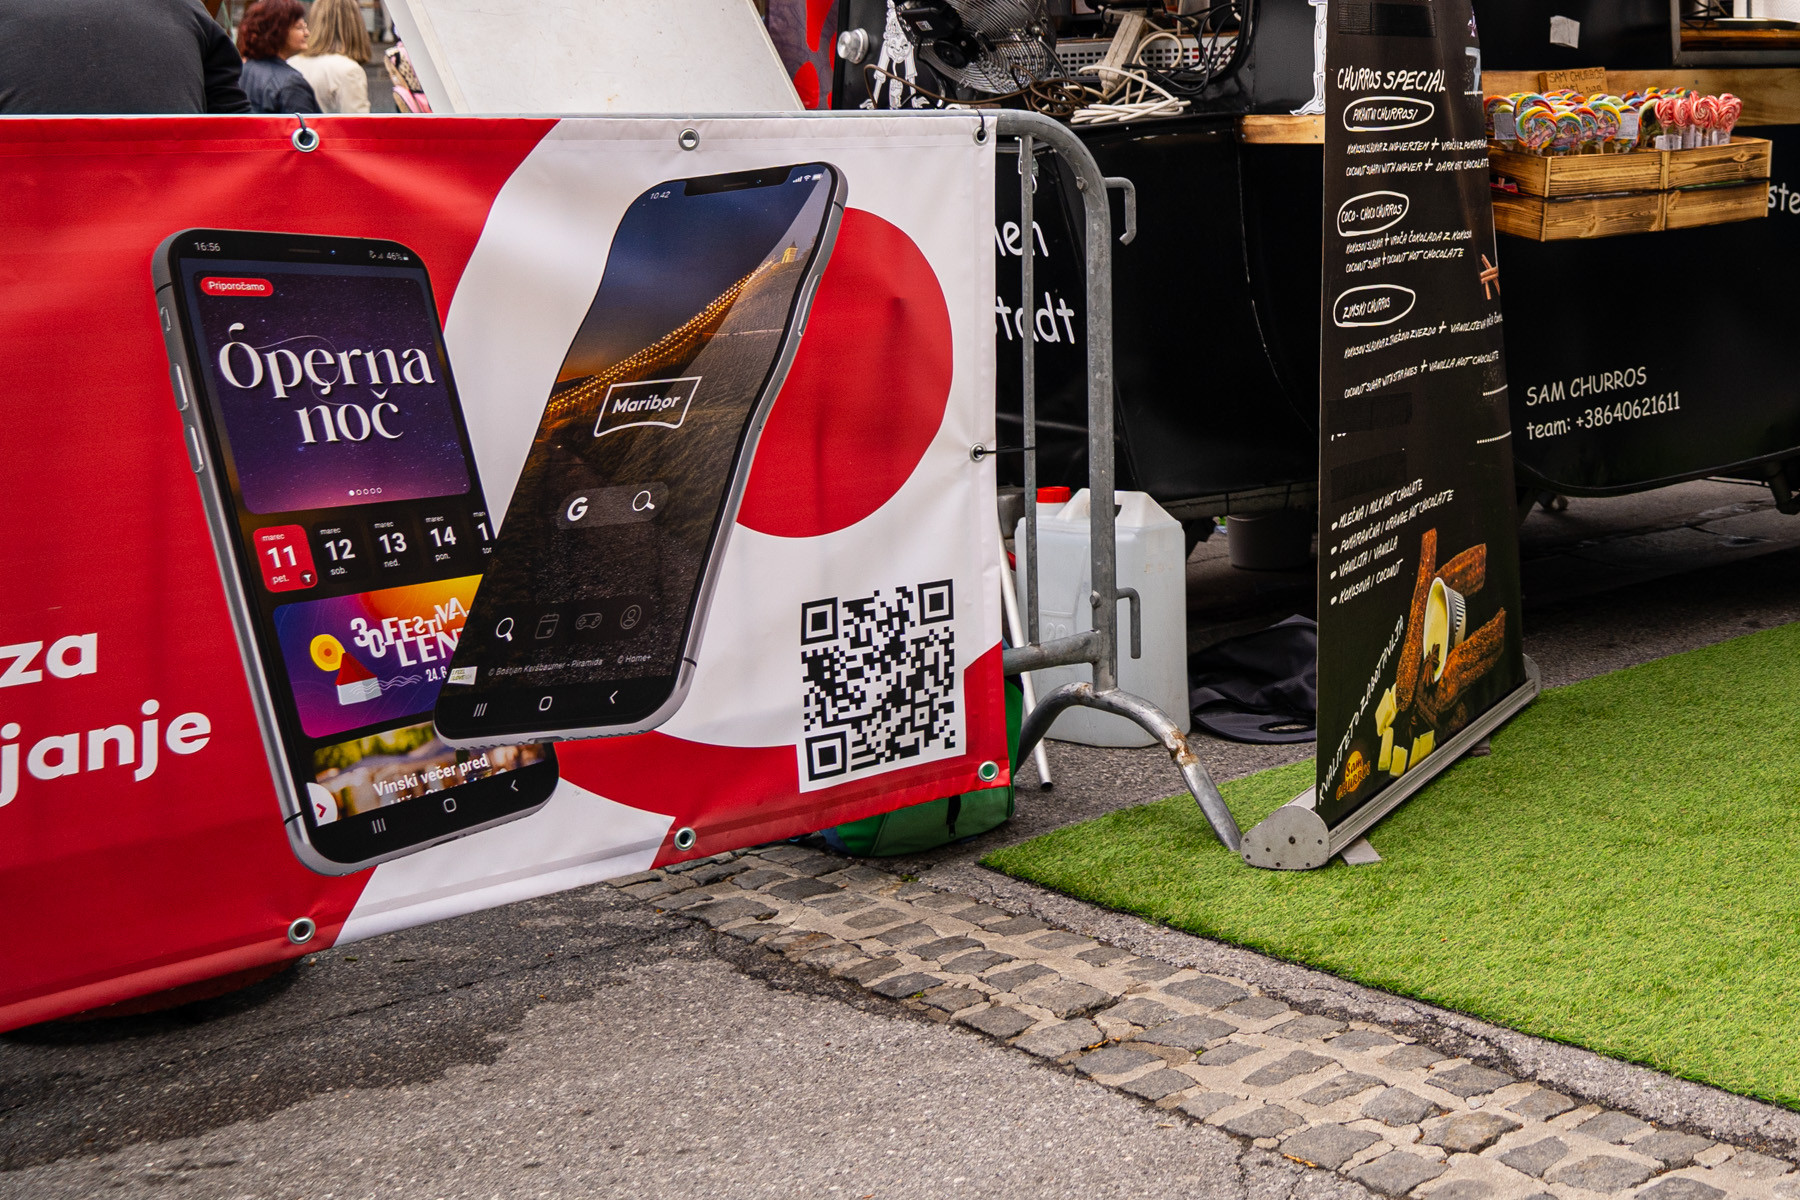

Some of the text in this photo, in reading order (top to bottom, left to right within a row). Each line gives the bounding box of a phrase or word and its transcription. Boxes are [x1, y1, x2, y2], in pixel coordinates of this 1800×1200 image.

[1338, 65, 1447, 92] CHURROS SPECIAL
[193, 241, 221, 253] 16:56
[206, 279, 266, 293] Priporočamo
[612, 393, 683, 416] Maribor
[1526, 366, 1648, 407] SAM CHURROS
[296, 388, 406, 444] noč
[1526, 390, 1681, 441] team: +38640621611
[262, 532, 285, 543] marec
[320, 526, 342, 536] marec
[267, 544, 299, 570] 11
[325, 537, 357, 562] 12
[379, 531, 408, 556] 13
[430, 525, 458, 549] 14
[272, 573, 290, 587] pet.
[330, 565, 349, 578] sob.
[384, 558, 401, 570] ned.
[435, 551, 451, 564] pon.
[383, 597, 471, 646] FESTIVA
[371, 772, 419, 798] Vinski
[420, 765, 461, 786] večer
[458, 752, 491, 777] pred
